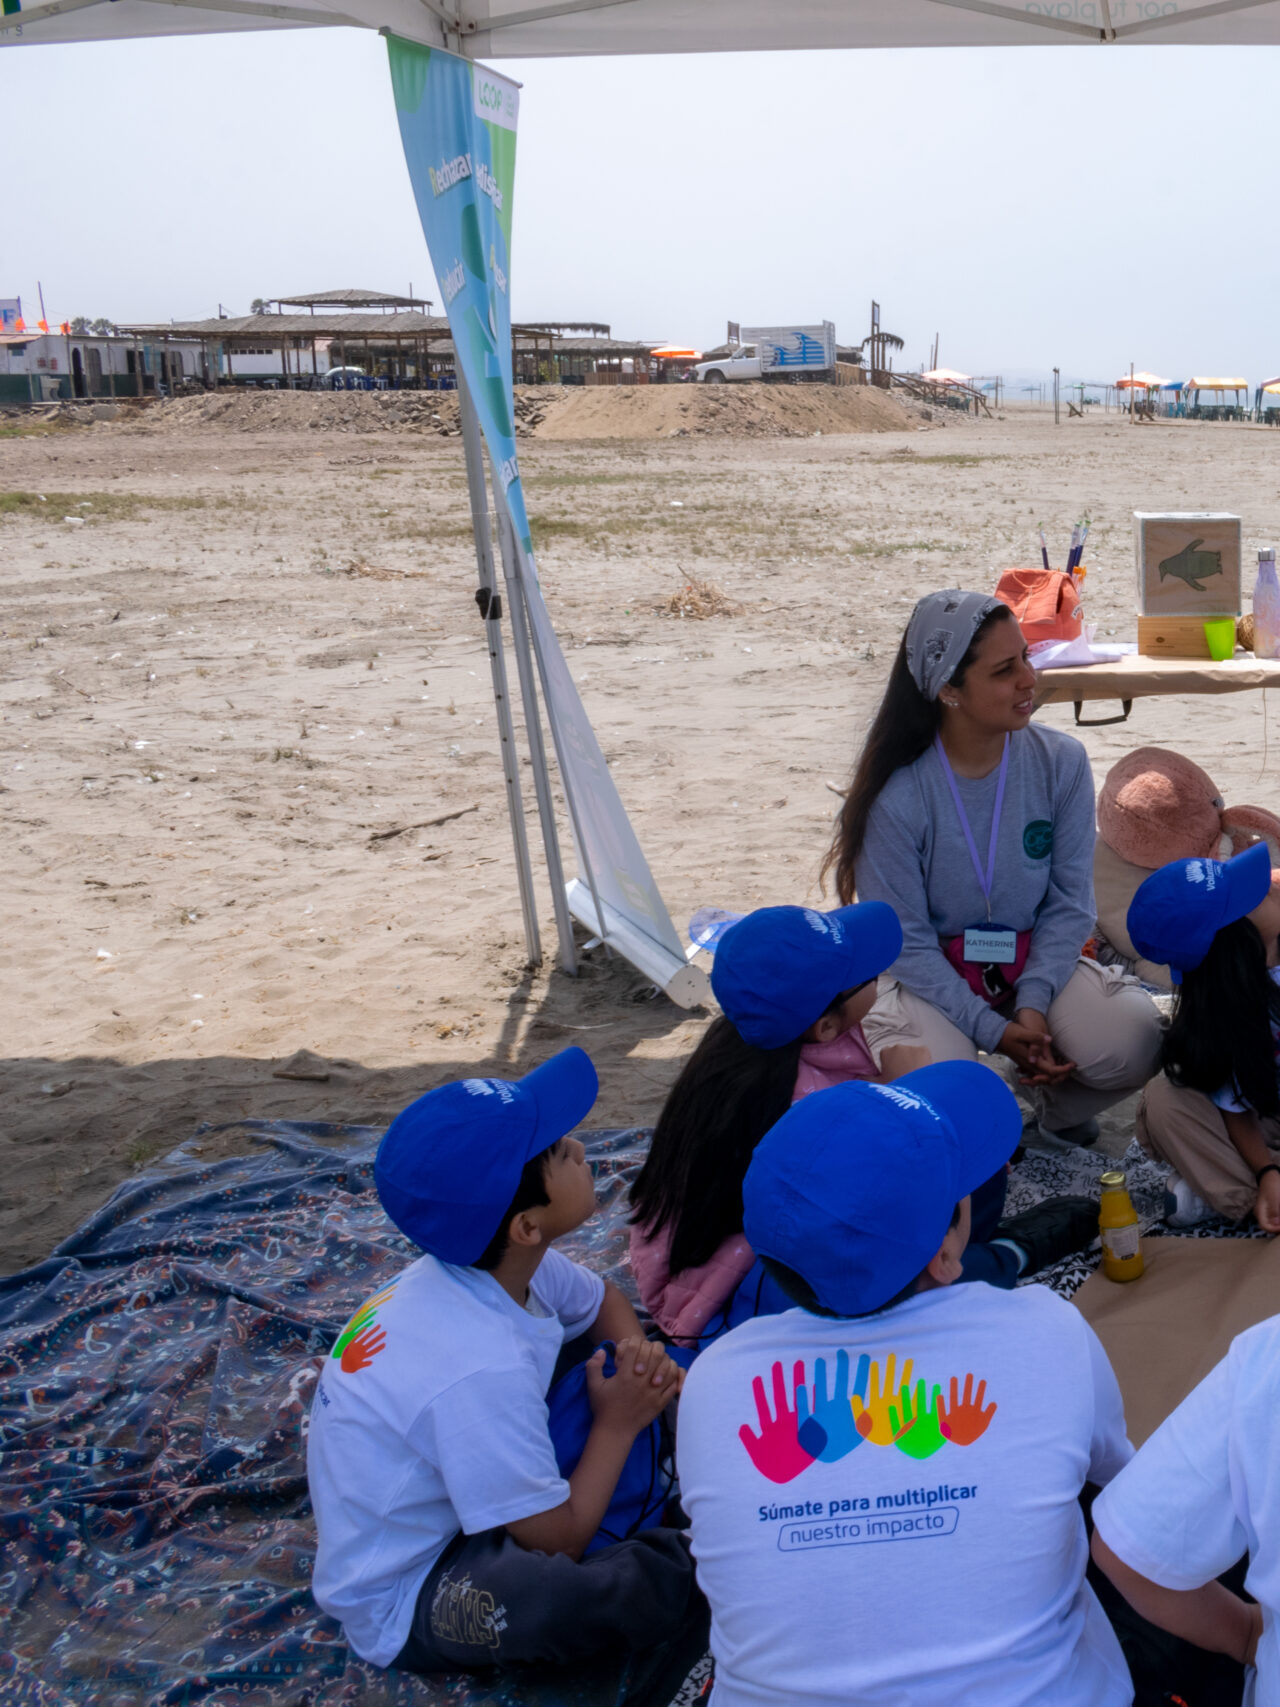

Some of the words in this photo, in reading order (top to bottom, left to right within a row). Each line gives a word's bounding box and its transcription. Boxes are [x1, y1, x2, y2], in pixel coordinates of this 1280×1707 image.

[965, 938, 1016, 949] KATHERINE
[758, 1503, 824, 1522] Súmate
[829, 1496, 871, 1517] para
[876, 1484, 978, 1509] multiplicar
[790, 1522, 861, 1544] nuestro
[866, 1513, 945, 1537] impacto
